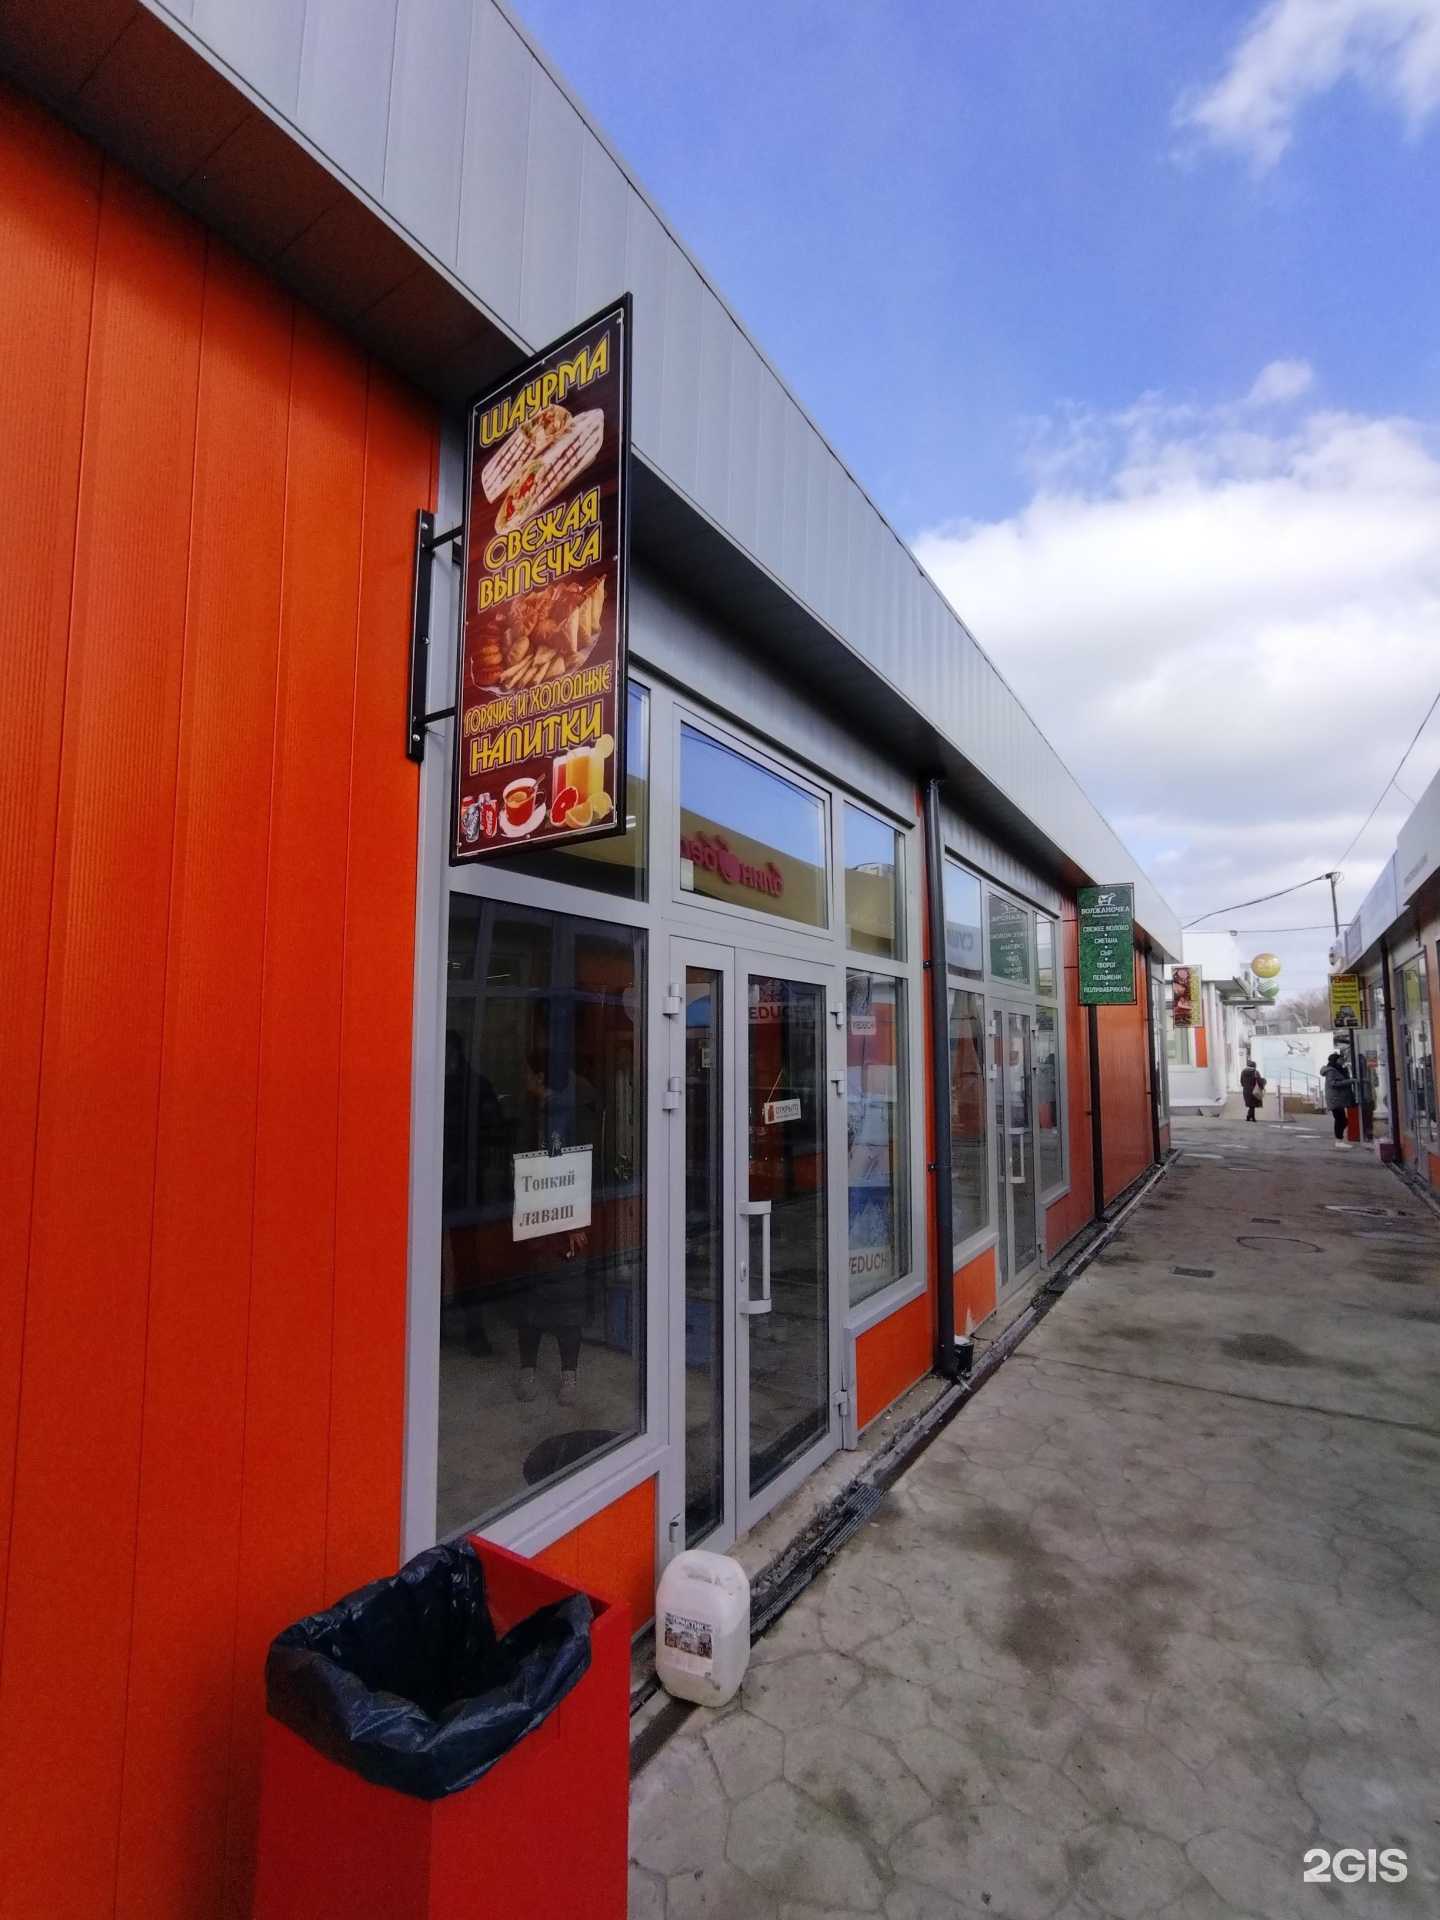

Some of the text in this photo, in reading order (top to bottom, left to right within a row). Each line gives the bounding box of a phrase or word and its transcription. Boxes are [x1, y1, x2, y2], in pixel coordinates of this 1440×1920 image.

[479, 331, 610, 448] ШАУРМА
[478, 522, 601, 612] ВЫПЕЧКА
[484, 486, 600, 572] СВЕЖАЯ
[464, 661, 612, 737] ГОРЯЧИЕ И ХОЛОДНЫЕ
[470, 701, 604, 776] НАПИТКИ
[521, 1169, 576, 1193] Тонкий
